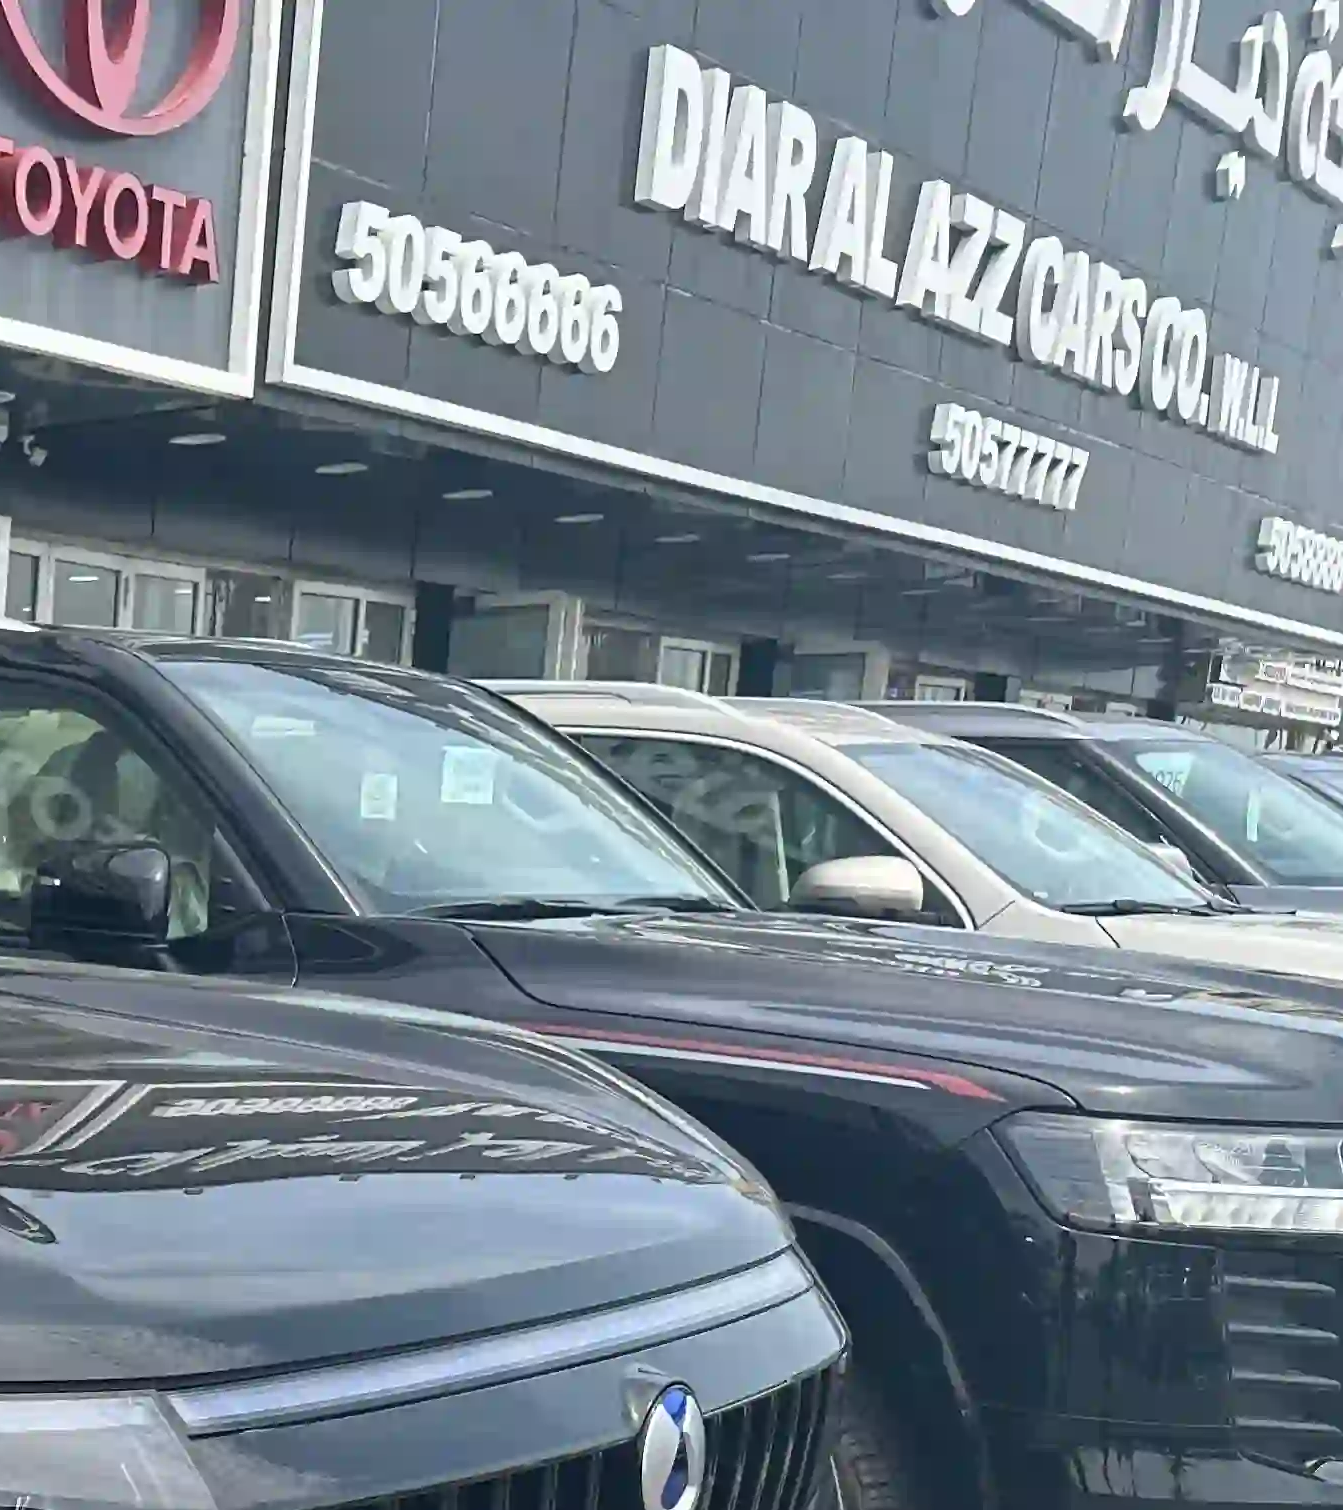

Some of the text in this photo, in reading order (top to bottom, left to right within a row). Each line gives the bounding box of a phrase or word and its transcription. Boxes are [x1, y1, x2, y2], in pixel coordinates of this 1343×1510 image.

[331, 200, 624, 374] 50566666
[633, 43, 817, 263] DIAR
[808, 136, 899, 300] AL
[895, 179, 1028, 347] AZZ
[1016, 236, 1147, 397] CARS
[1138, 296, 1210, 427] CO.
[928, 403, 1090, 510] 50577777
